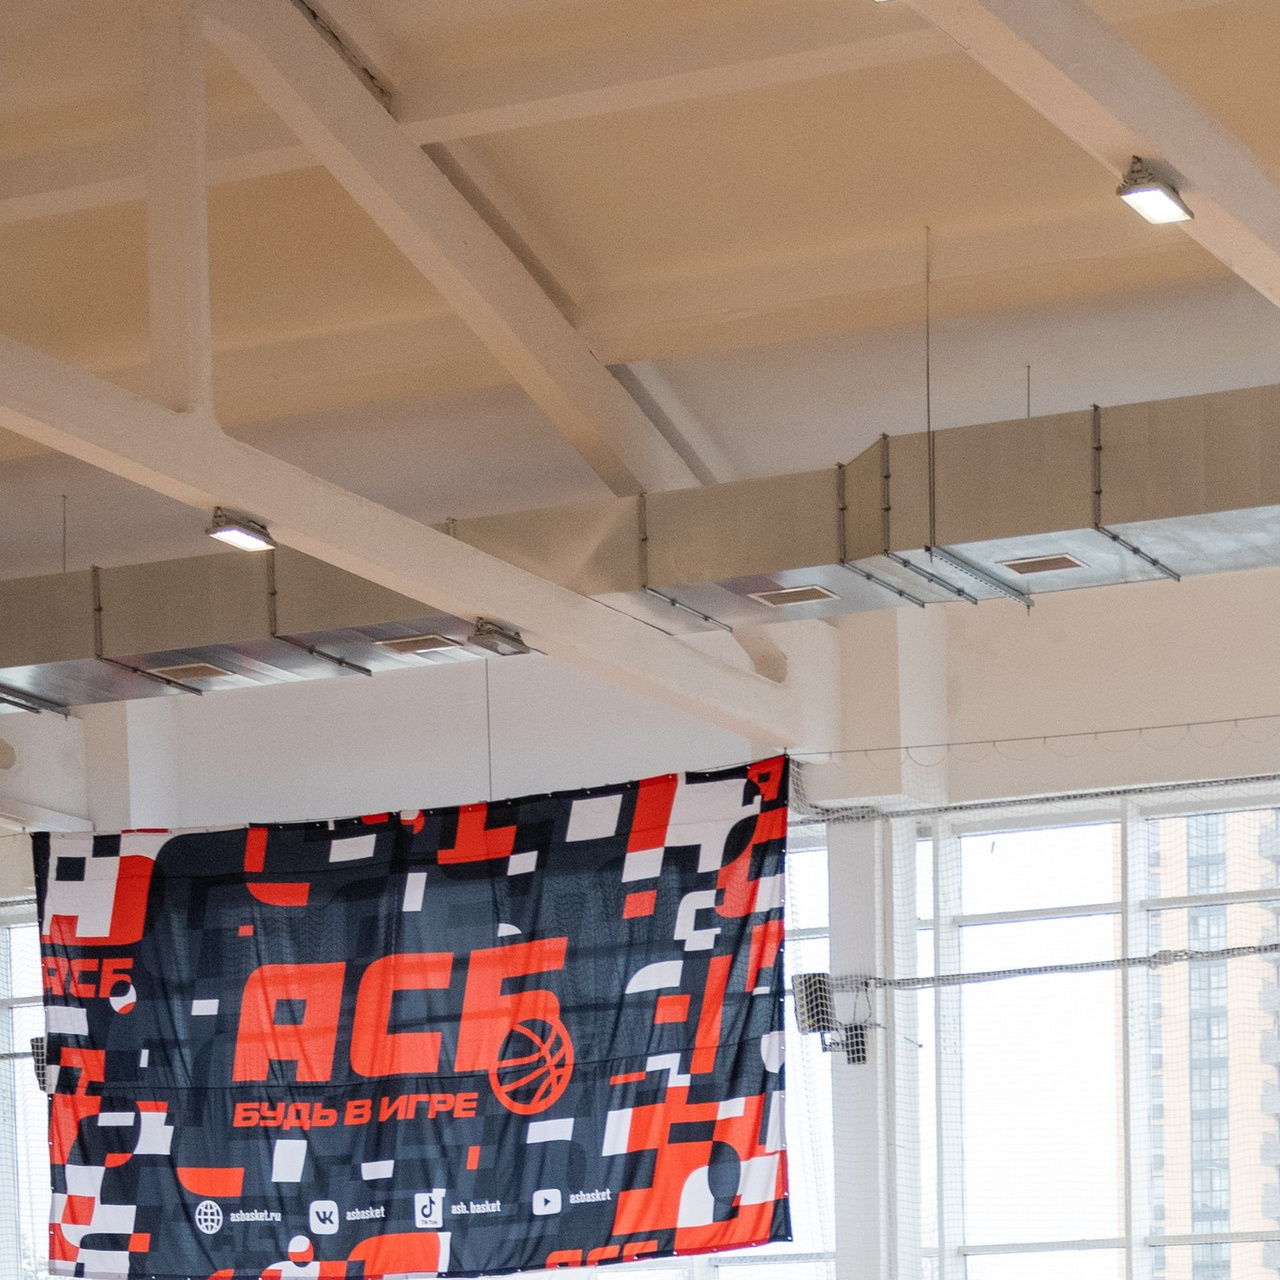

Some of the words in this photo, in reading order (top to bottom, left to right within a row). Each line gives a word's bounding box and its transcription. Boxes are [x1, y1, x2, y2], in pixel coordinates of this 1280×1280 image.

[232, 937, 568, 1082] АСБ
[233, 1102, 337, 1131] БУДЬ
[344, 1098, 372, 1126] В
[378, 1092, 478, 1122] ИГРЕ
[569, 1188, 612, 1204] asbasket
[230, 1209, 282, 1222] asbasket.ru
[345, 1206, 386, 1221] asbasket
